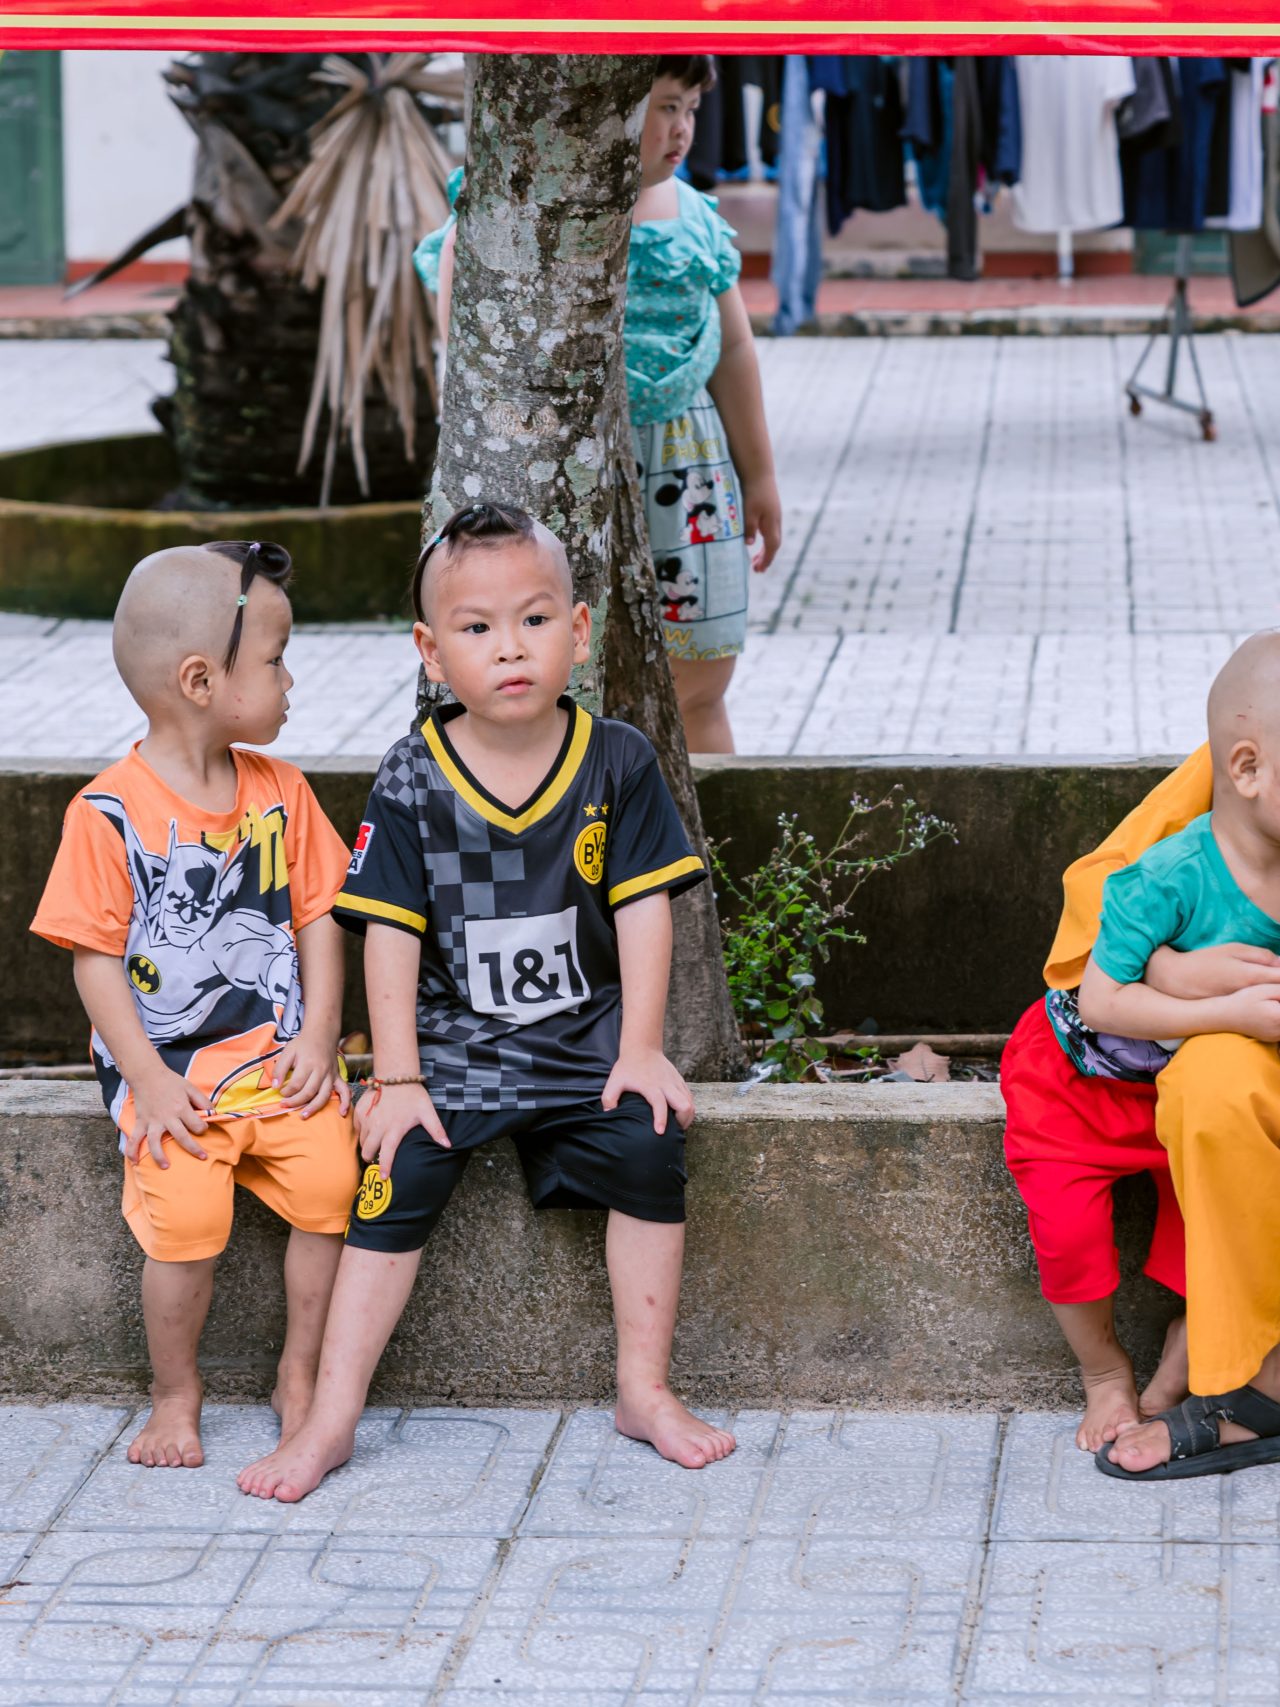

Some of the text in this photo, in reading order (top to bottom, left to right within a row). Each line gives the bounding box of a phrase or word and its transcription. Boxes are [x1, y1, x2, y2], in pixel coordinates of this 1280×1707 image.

[584, 831, 605, 864] BVB
[478, 939, 585, 1007] 1&1
[360, 1172, 384, 1201] BVB
